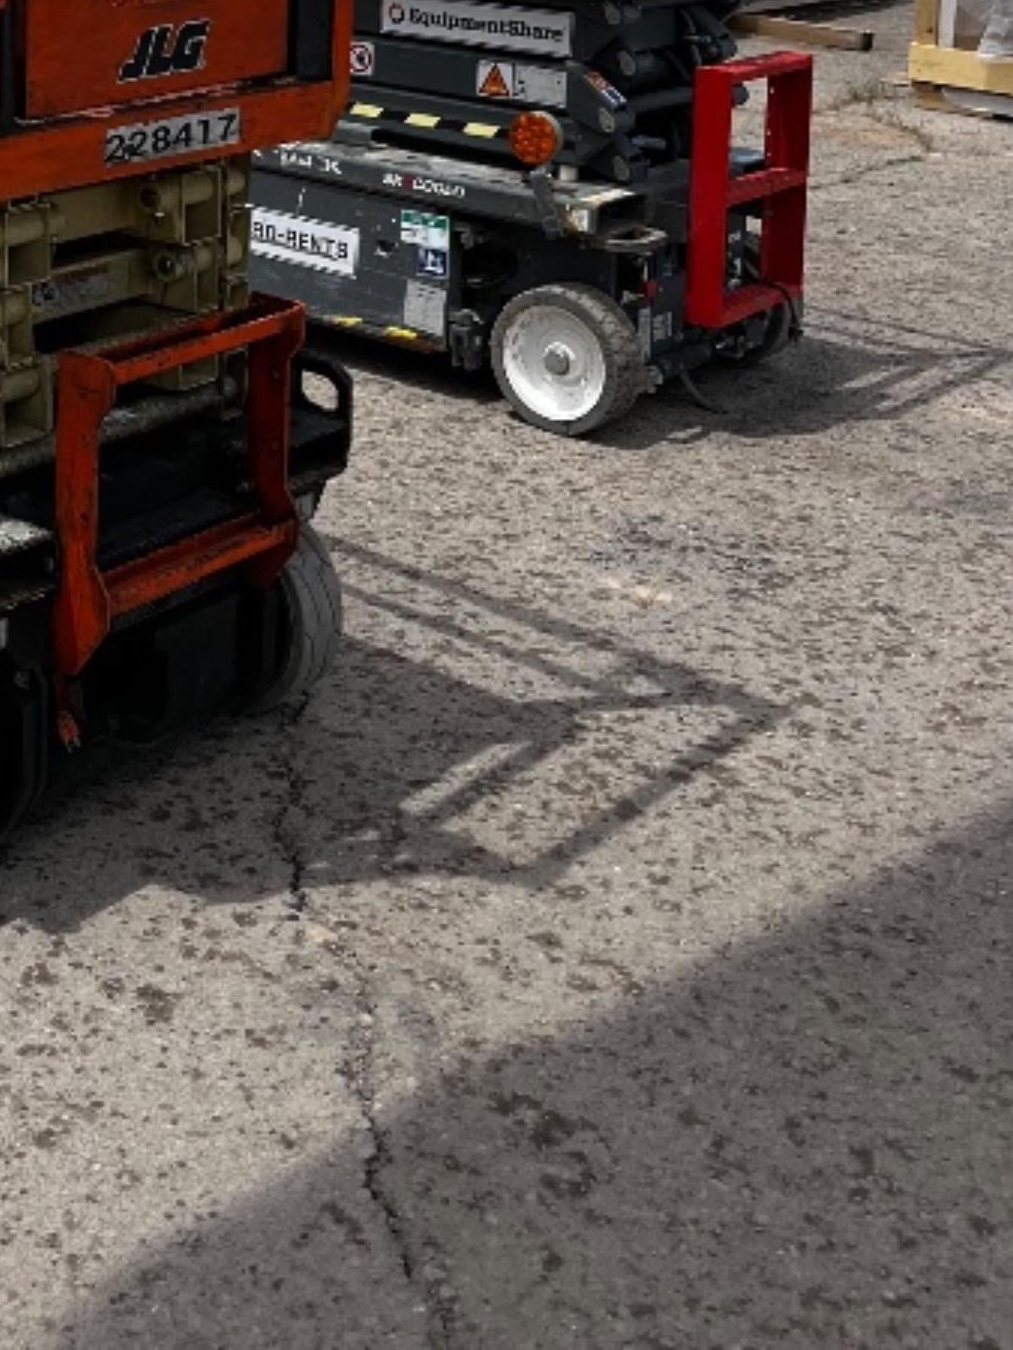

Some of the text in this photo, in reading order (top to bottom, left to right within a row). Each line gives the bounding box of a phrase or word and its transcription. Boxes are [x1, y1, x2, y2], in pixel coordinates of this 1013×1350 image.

[116, 18, 211, 84] JLG
[409, 8, 565, 43] EquipmentShare
[104, 113, 237, 165] 228417
